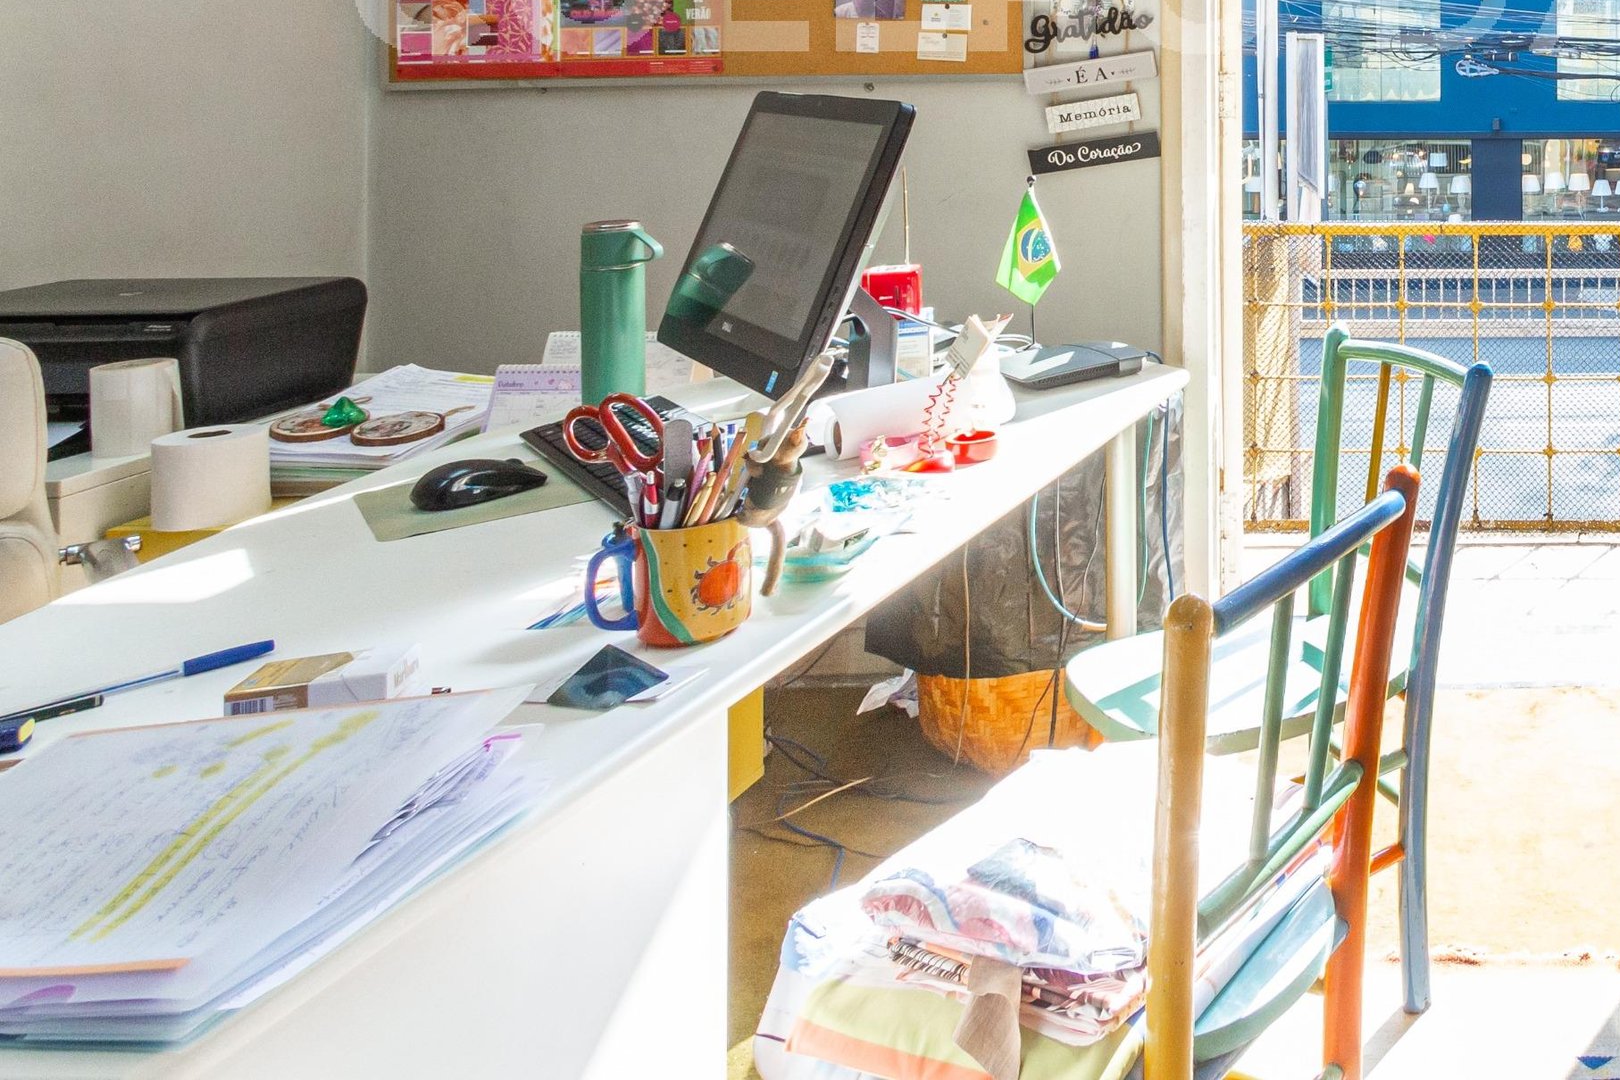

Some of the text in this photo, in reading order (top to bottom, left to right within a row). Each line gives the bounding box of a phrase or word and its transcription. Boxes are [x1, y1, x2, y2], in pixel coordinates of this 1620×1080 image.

[1075, 66, 1108, 84] É A
[1059, 104, 1132, 123] Memória
[1048, 142, 1142, 166] Do Coração
